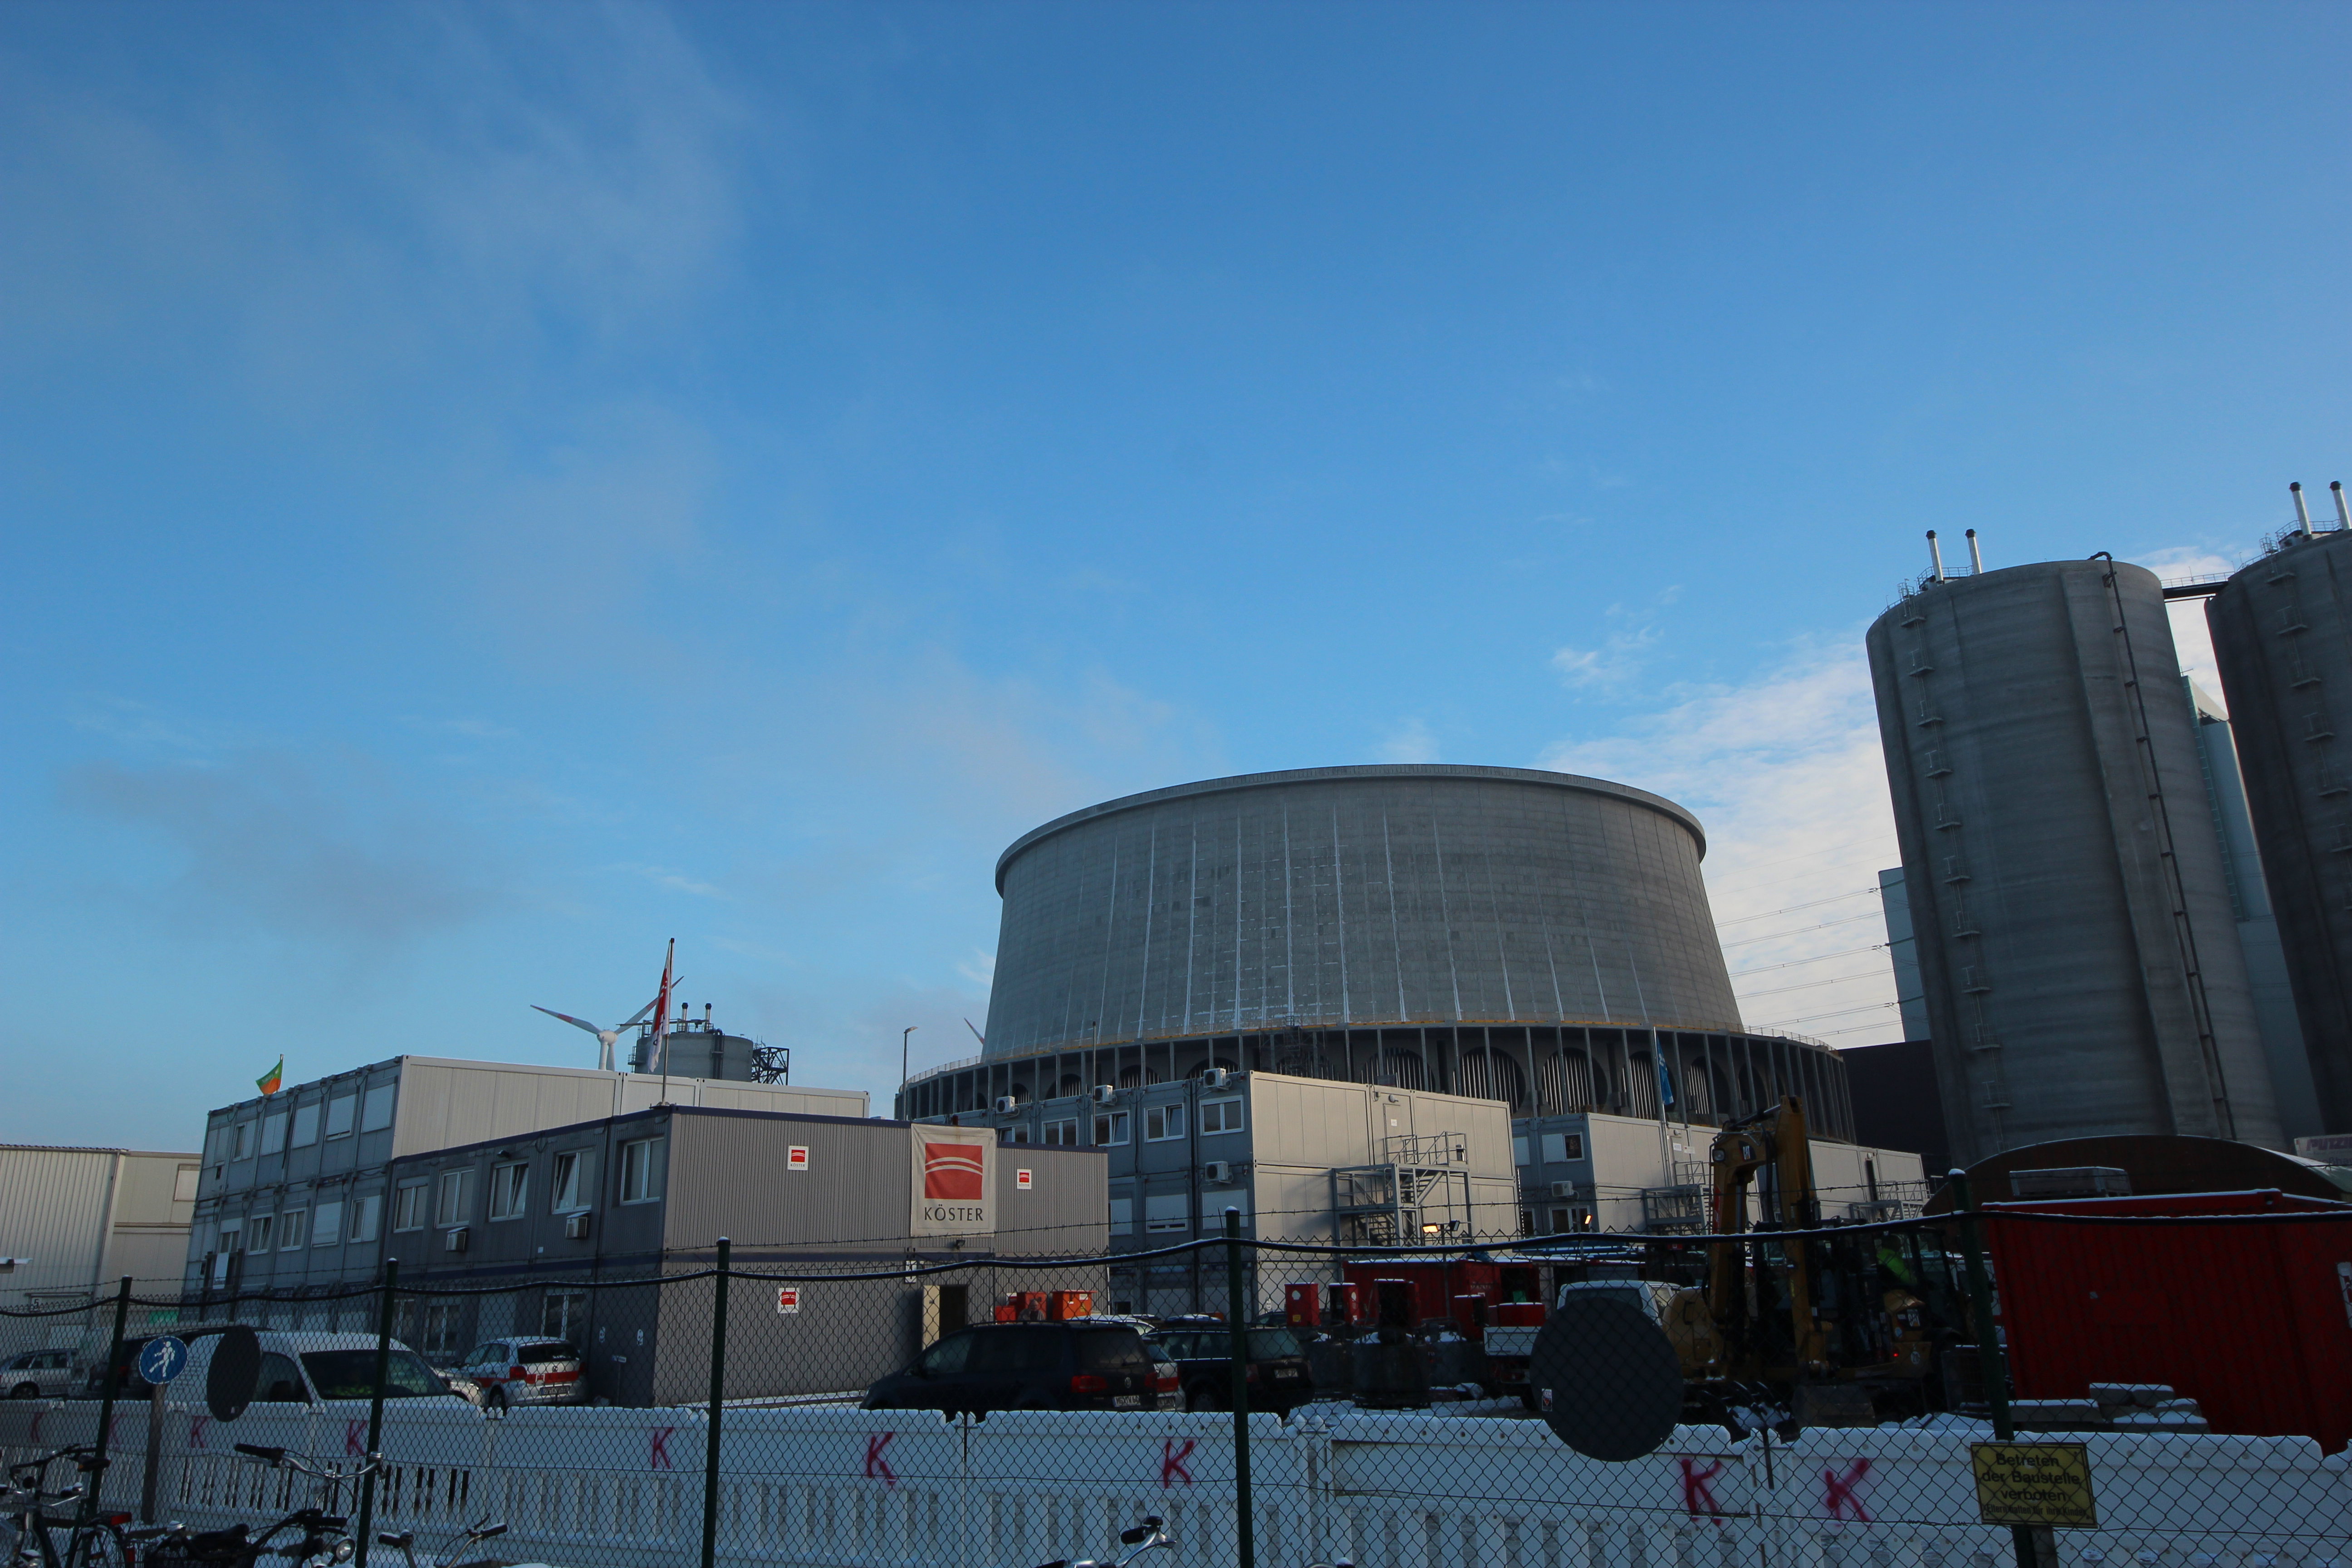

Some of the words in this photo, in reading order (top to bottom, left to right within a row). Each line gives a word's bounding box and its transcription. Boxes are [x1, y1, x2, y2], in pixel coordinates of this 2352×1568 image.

[925, 1204, 983, 1221] KÖSTER
[34, 1298, 39, 1309] 5
[191, 1416, 208, 1448] K
[347, 1420, 367, 1455] K
[652, 1427, 673, 1469] K
[866, 1432, 895, 1485] K
[1162, 1440, 1195, 1488] K
[1996, 1453, 2060, 1466] Betreten
[1681, 1458, 1722, 1526] K
[1824, 1458, 1871, 1526] K
[1982, 1470, 2005, 1482] der
[2012, 1471, 2080, 1484] Baustelle
[1986, 1504, 2007, 1514] Eltern
[2009, 1505, 2031, 1514] haften
[2047, 1506, 2061, 1516] ihre
[2063, 1507, 2086, 1517] Kinder
[2001, 1489, 2067, 1501] verboten
